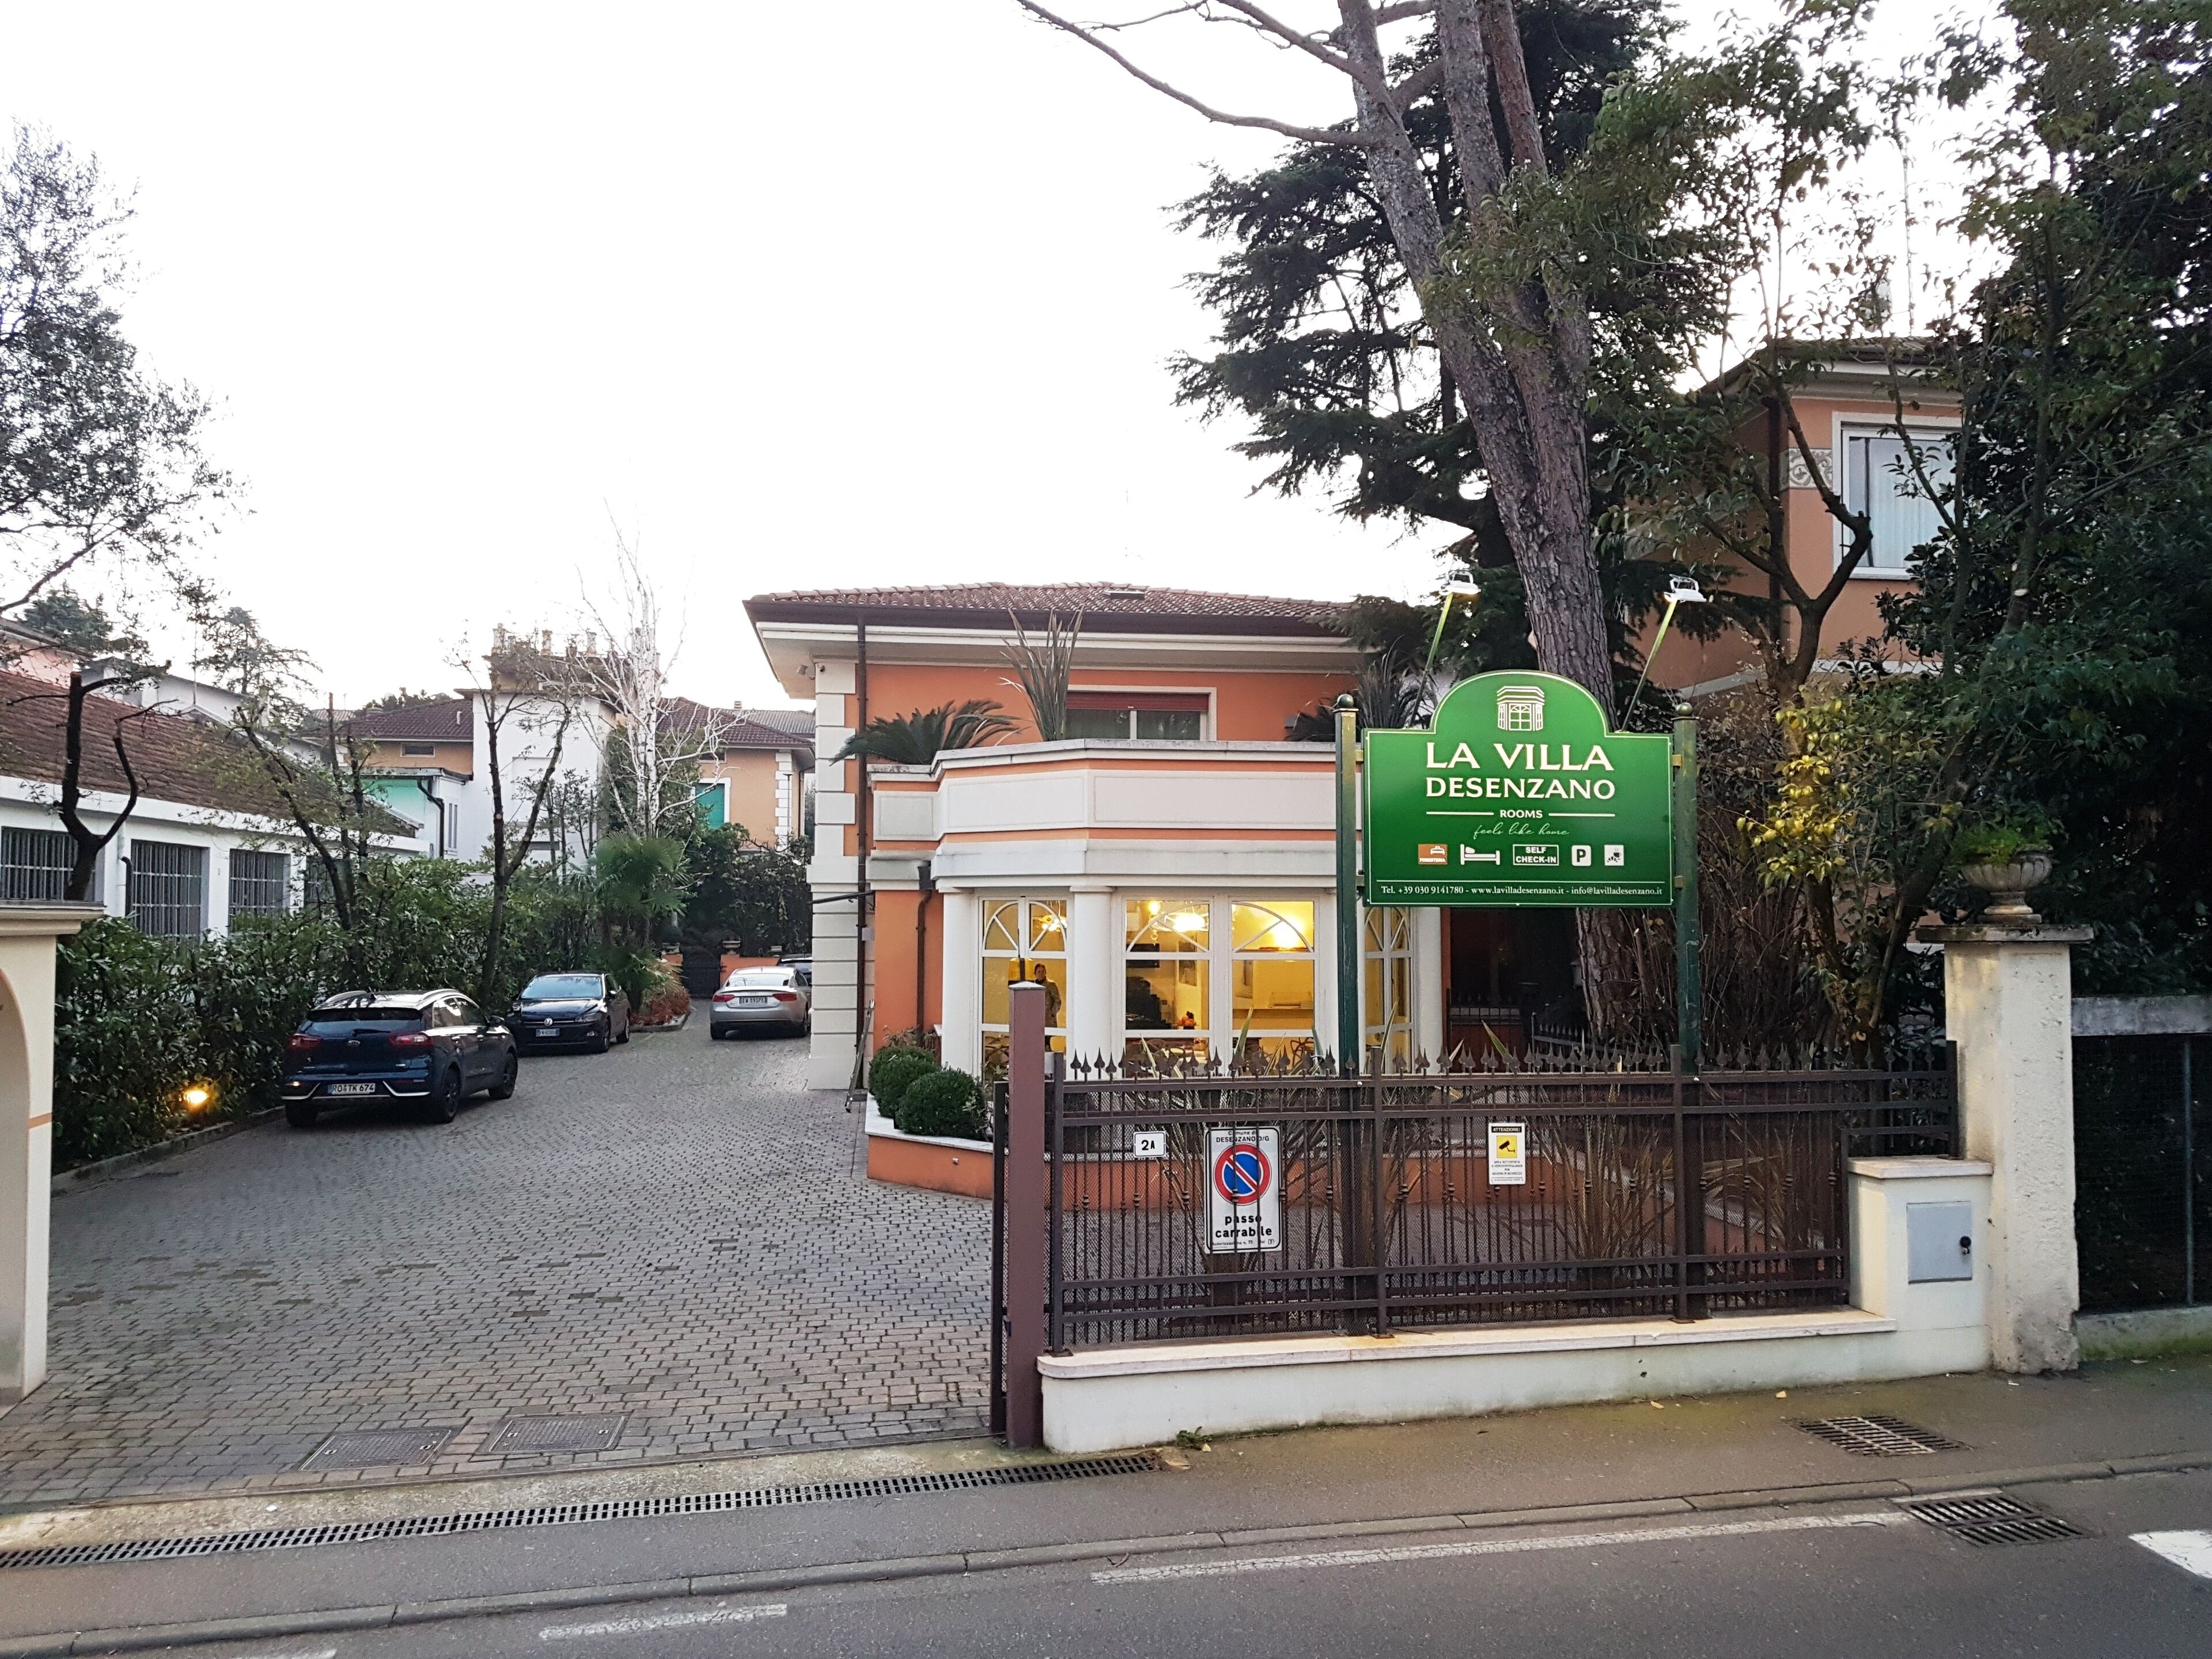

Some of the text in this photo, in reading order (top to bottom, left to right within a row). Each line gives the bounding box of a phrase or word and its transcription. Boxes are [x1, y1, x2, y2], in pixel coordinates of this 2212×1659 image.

[1426, 742, 1614, 771] LA VILLA
[1426, 777, 1615, 800] DESENZANO
[1500, 809, 1543, 819] ROOMS
[1473, 821, 1569, 840] feels like home
[1576, 849, 1586, 862] P
[1398, 886, 1413, 894] +39
[1415, 886, 1429, 894] 030
[1431, 886, 1464, 894] 9141780
[1471, 886, 1564, 894] www.lavilladesenzano.it
[1571, 887, 1662, 895] info@lavilladesenzano.it
[1141, 1139, 1155, 1151] 2A
[1215, 1226, 1272, 1238] carrable
